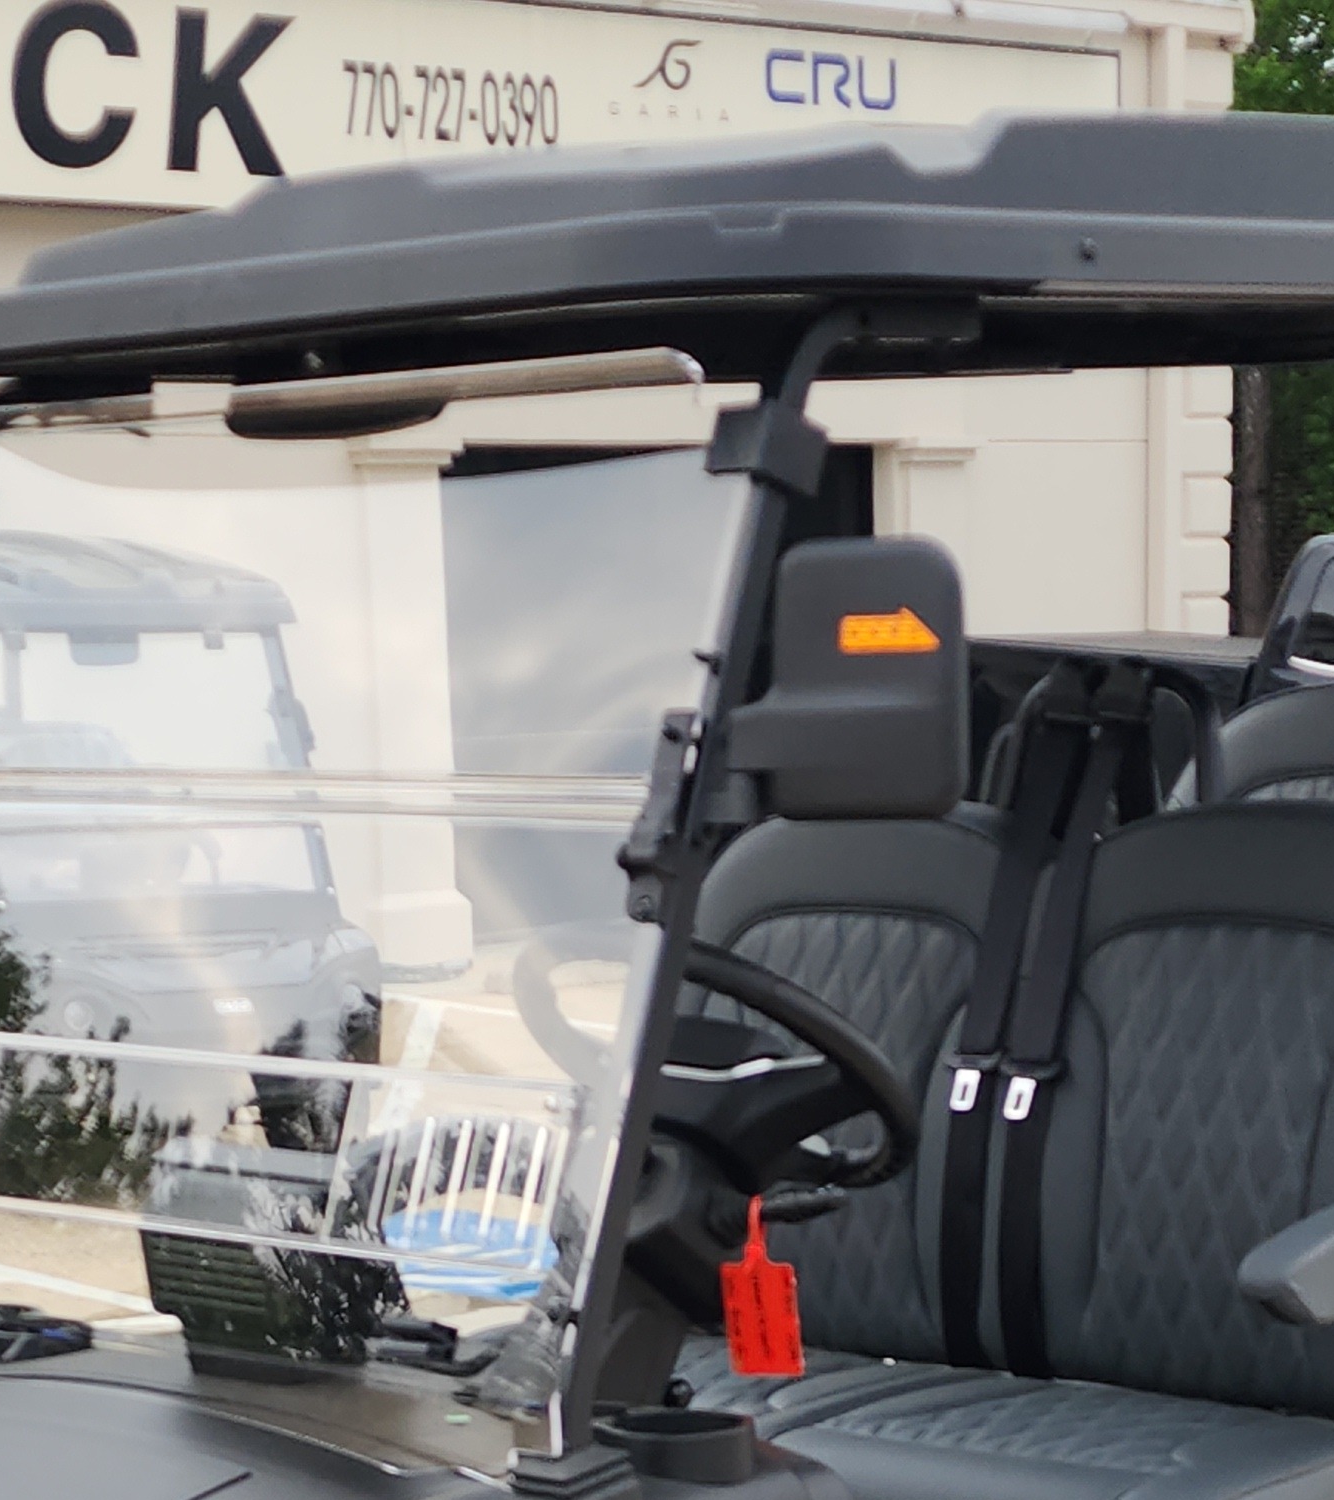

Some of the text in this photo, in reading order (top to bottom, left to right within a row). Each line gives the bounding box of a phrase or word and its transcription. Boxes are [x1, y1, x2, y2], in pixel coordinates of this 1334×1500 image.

[343, 60, 559, 147] 770-727-0390
[766, 48, 897, 110] CRU
[608, 101, 729, 122] GARIA
